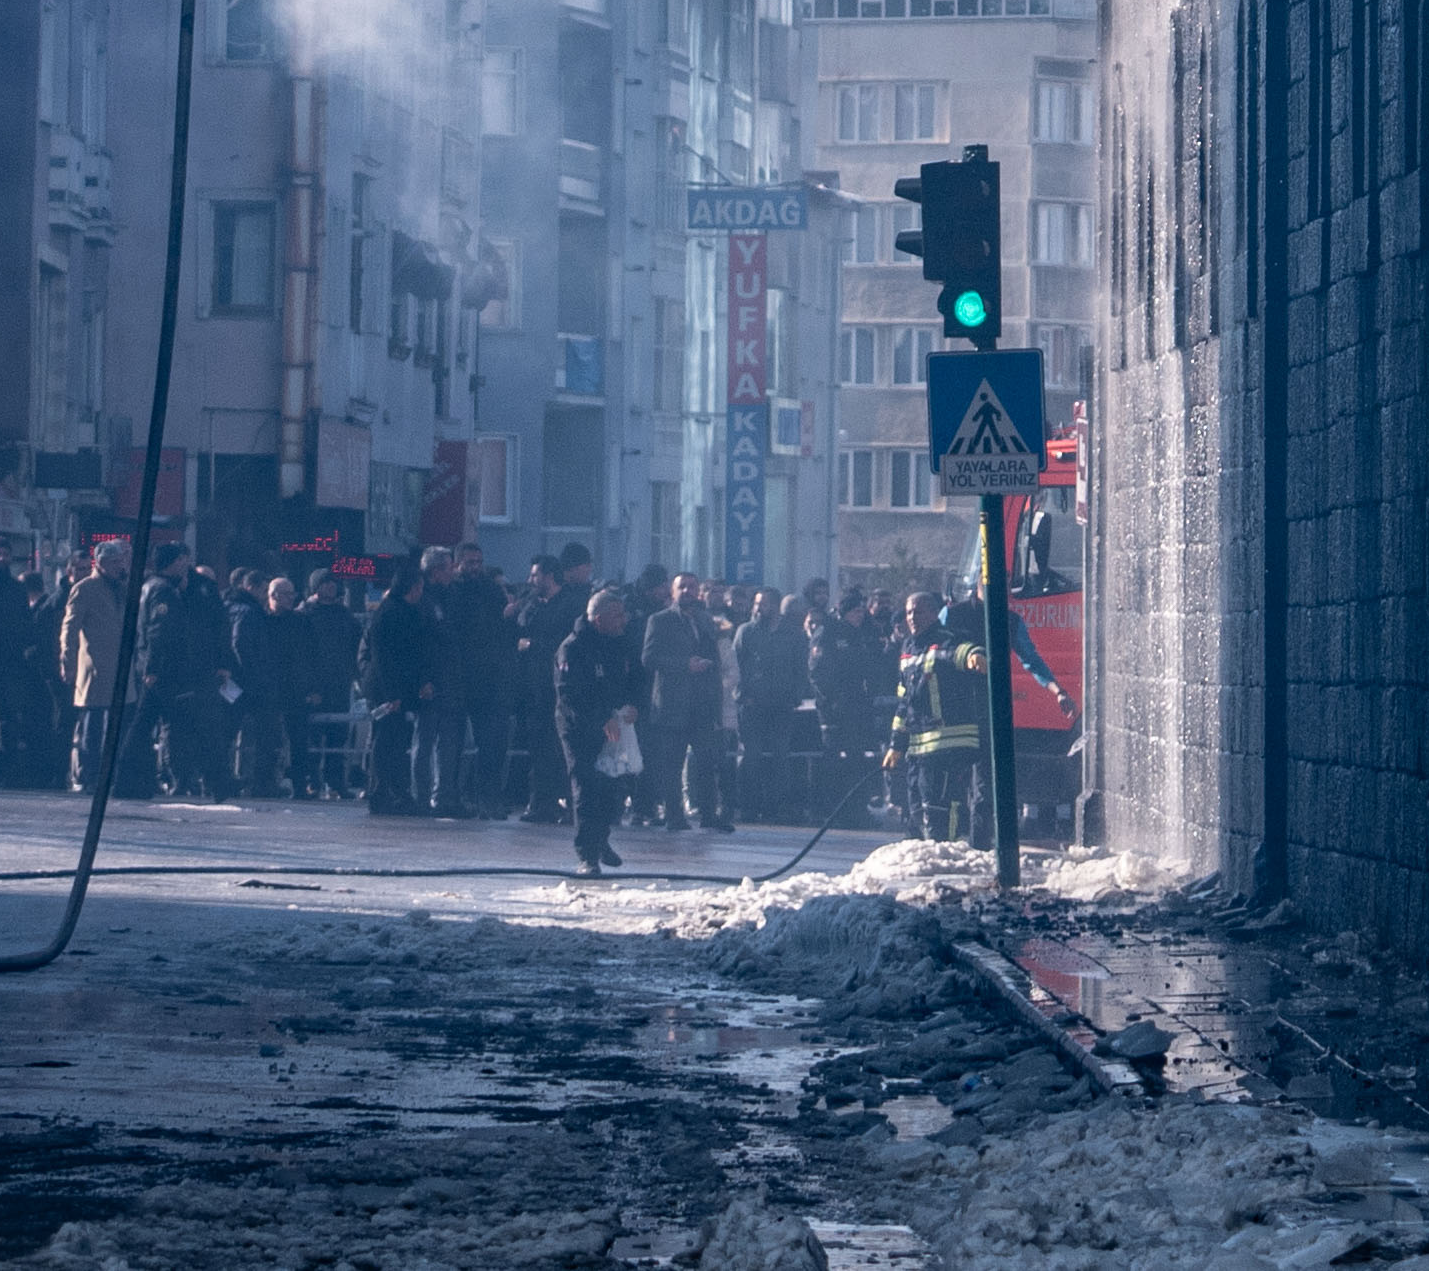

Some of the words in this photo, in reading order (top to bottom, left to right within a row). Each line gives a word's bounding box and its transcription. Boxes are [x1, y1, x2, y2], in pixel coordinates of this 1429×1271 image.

[691, 195, 801, 226] AKDAĞ
[734, 238, 761, 399] YUFKA
[955, 460, 1028, 473] YAYALARA
[949, 474, 976, 488] YOL
[1009, 602, 1081, 628] RZURUM
